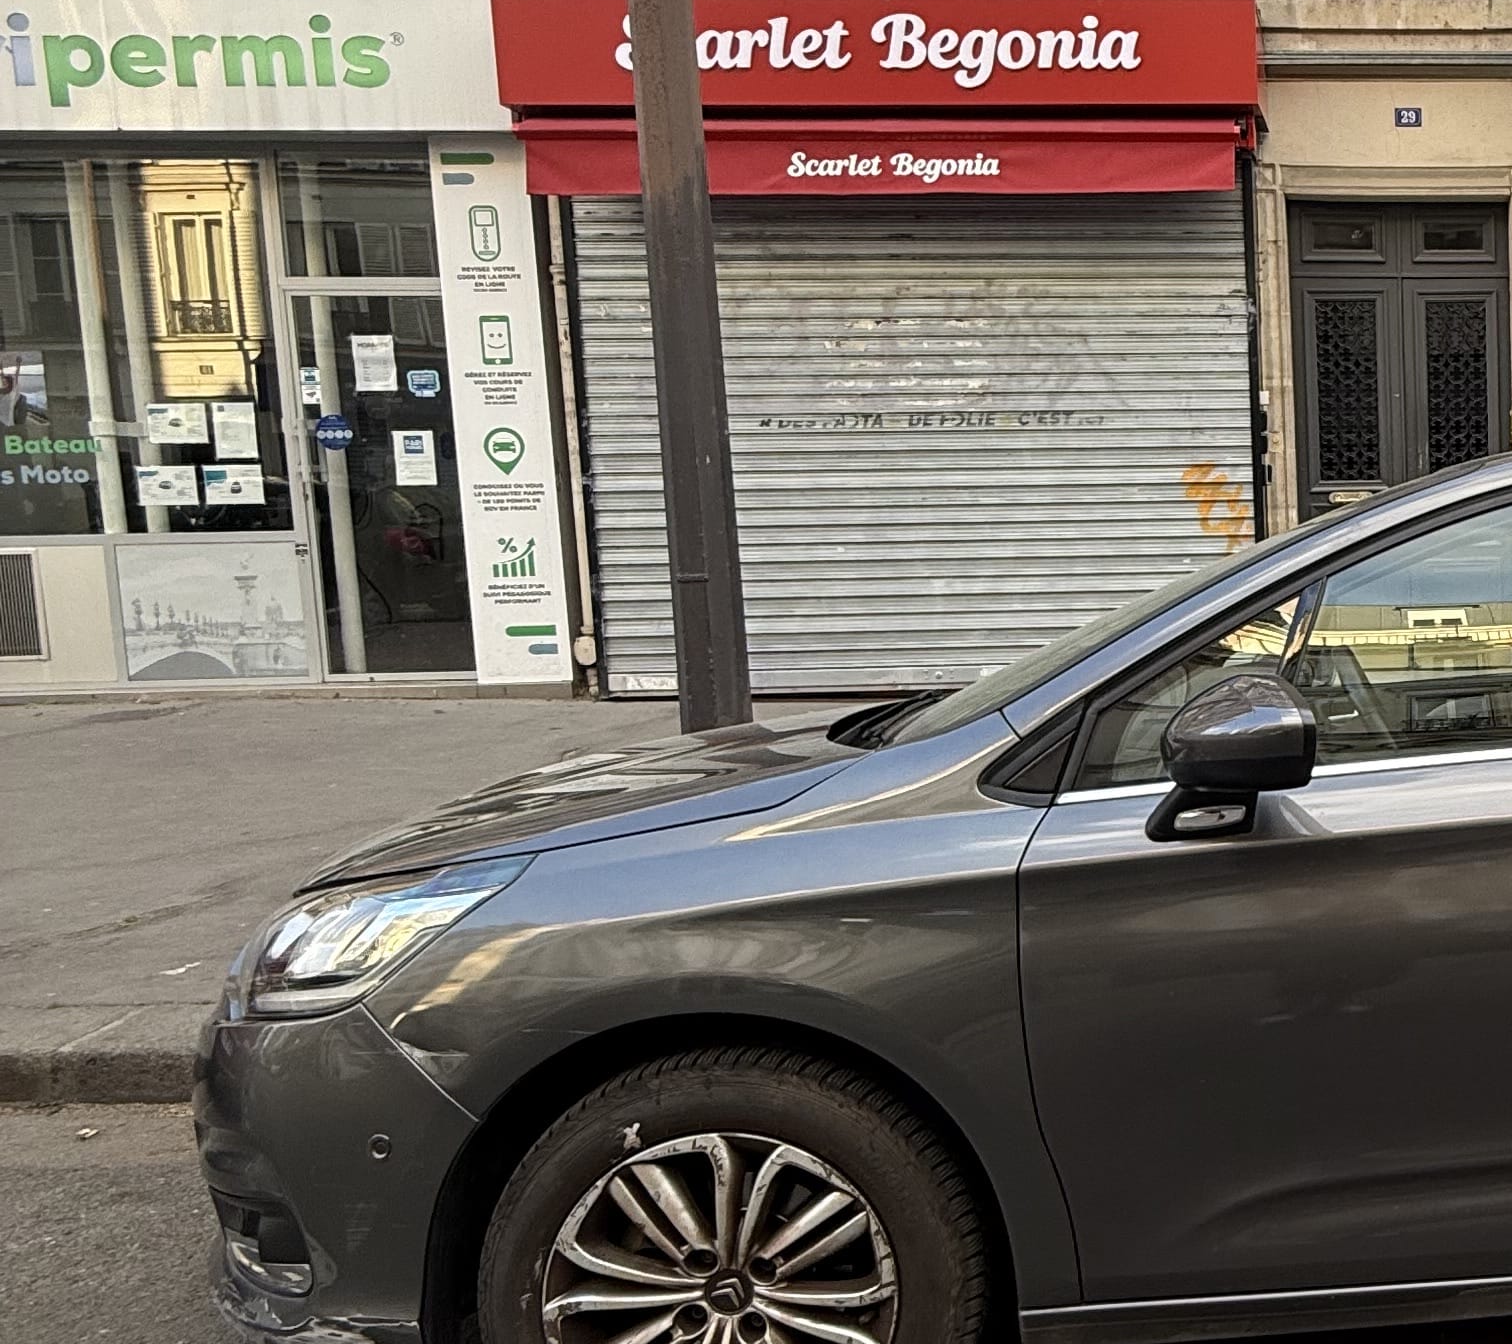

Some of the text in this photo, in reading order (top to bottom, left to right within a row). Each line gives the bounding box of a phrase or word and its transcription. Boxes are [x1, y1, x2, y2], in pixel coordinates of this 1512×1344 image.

[0, 12, 392, 107] ipermis
[616, 13, 1142, 89] arlet Begonia
[1400, 110, 1416, 124] 29
[787, 151, 1001, 184] Scarlet Begonia
[4, 435, 103, 454] Bateau
[20, 464, 90, 484] Moto
